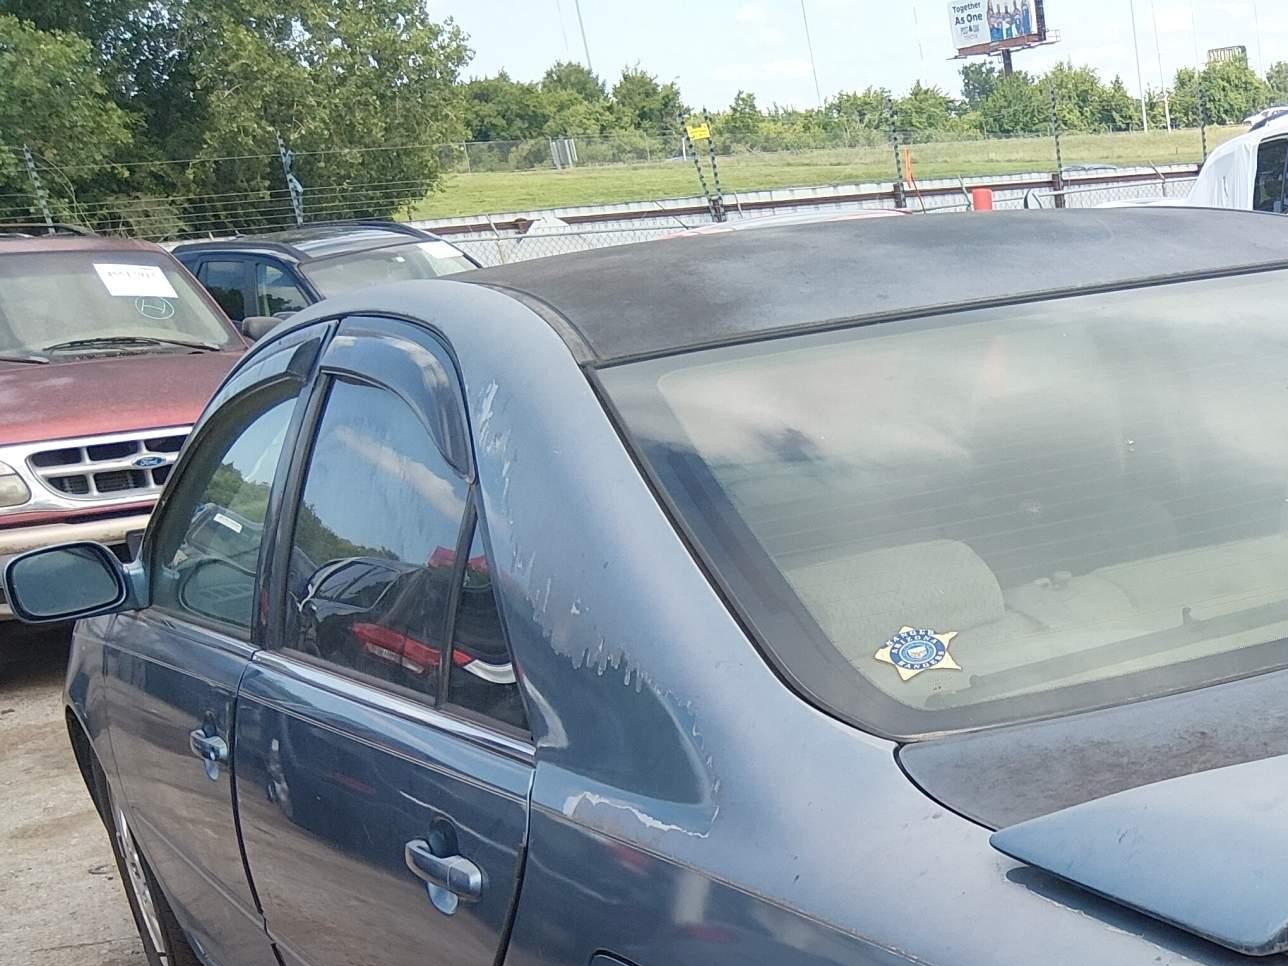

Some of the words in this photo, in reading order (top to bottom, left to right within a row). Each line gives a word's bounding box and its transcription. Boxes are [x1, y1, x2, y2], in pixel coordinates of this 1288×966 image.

[952, 2, 981, 13] Together
[955, 16, 965, 25] As
[966, 13, 983, 23] One
